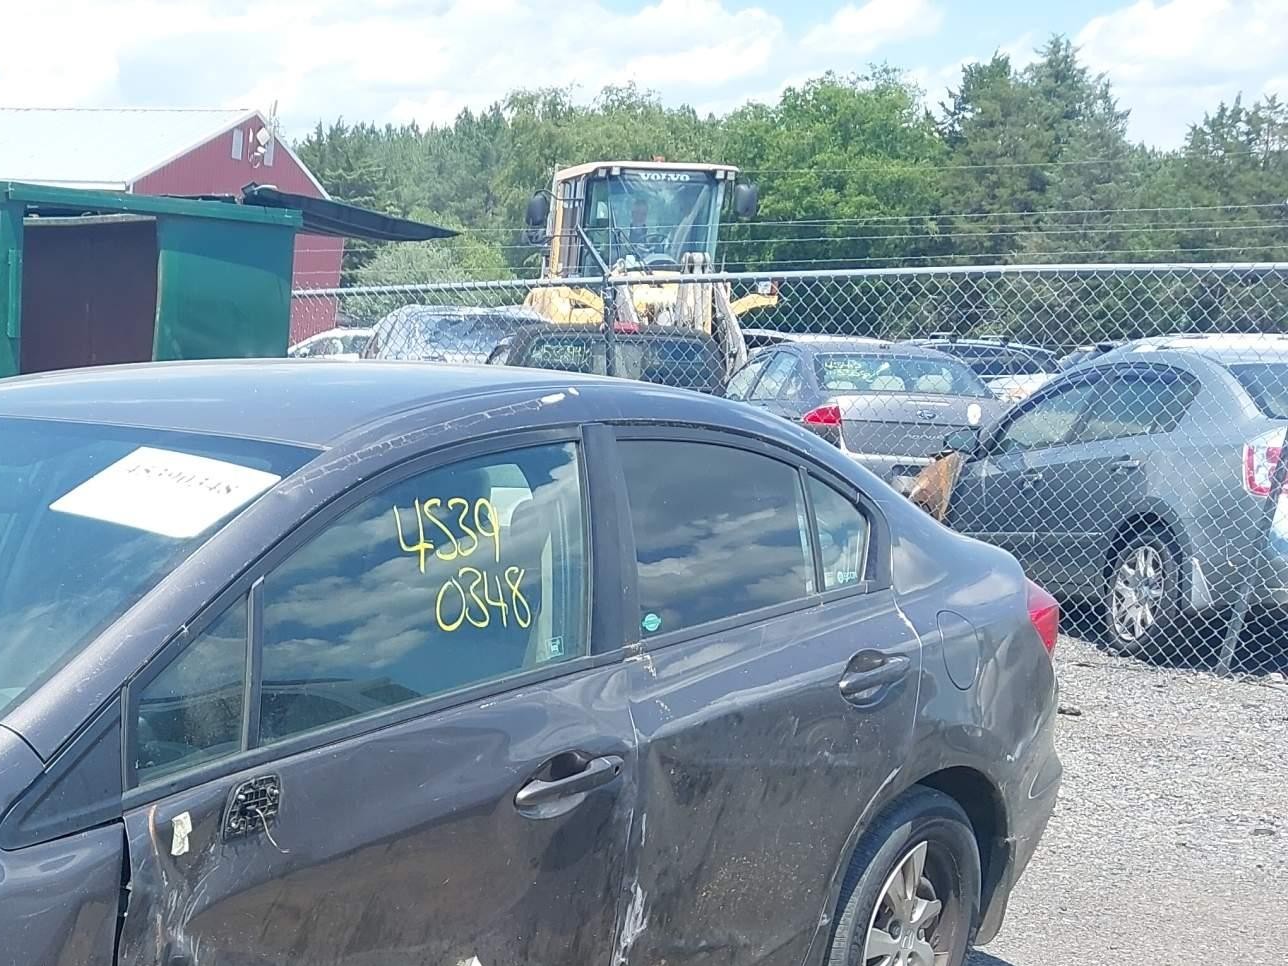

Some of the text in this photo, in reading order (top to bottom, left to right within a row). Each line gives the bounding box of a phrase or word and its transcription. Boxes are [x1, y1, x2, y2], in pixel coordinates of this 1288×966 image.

[638, 172, 691, 182] VOLVO
[393, 497, 500, 574] 4539
[435, 566, 532, 632] 0348
